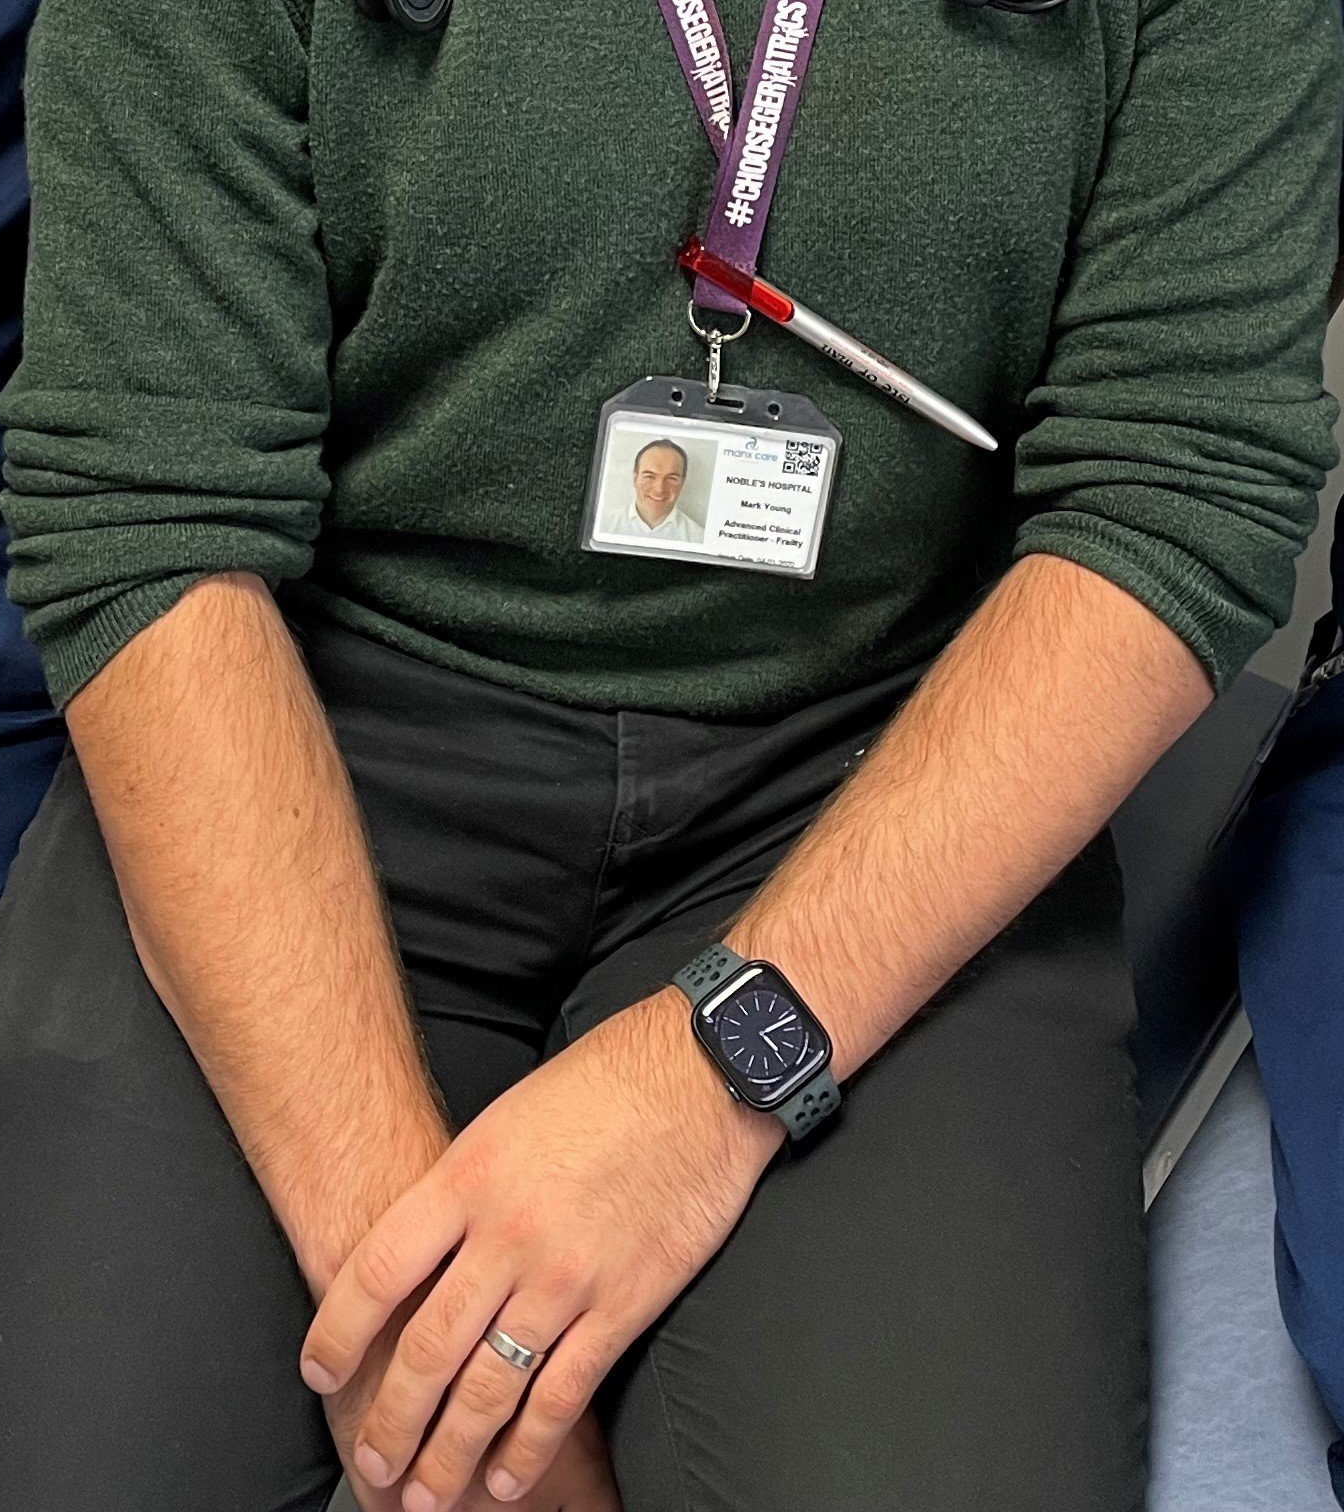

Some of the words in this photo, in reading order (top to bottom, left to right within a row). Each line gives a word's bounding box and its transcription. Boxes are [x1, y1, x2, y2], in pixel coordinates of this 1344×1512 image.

[723, 448, 752, 459] manx
[755, 452, 778, 462] care
[726, 476, 766, 488] NOBLE'S
[768, 481, 813, 494] HOSPITAL
[740, 500, 761, 510] Mark
[764, 503, 792, 515] Young
[724, 520, 767, 532] Advanced
[769, 525, 802, 536] Clinical
[719, 530, 769, 542] Practitioner
[776, 537, 804, 548] Frailty
